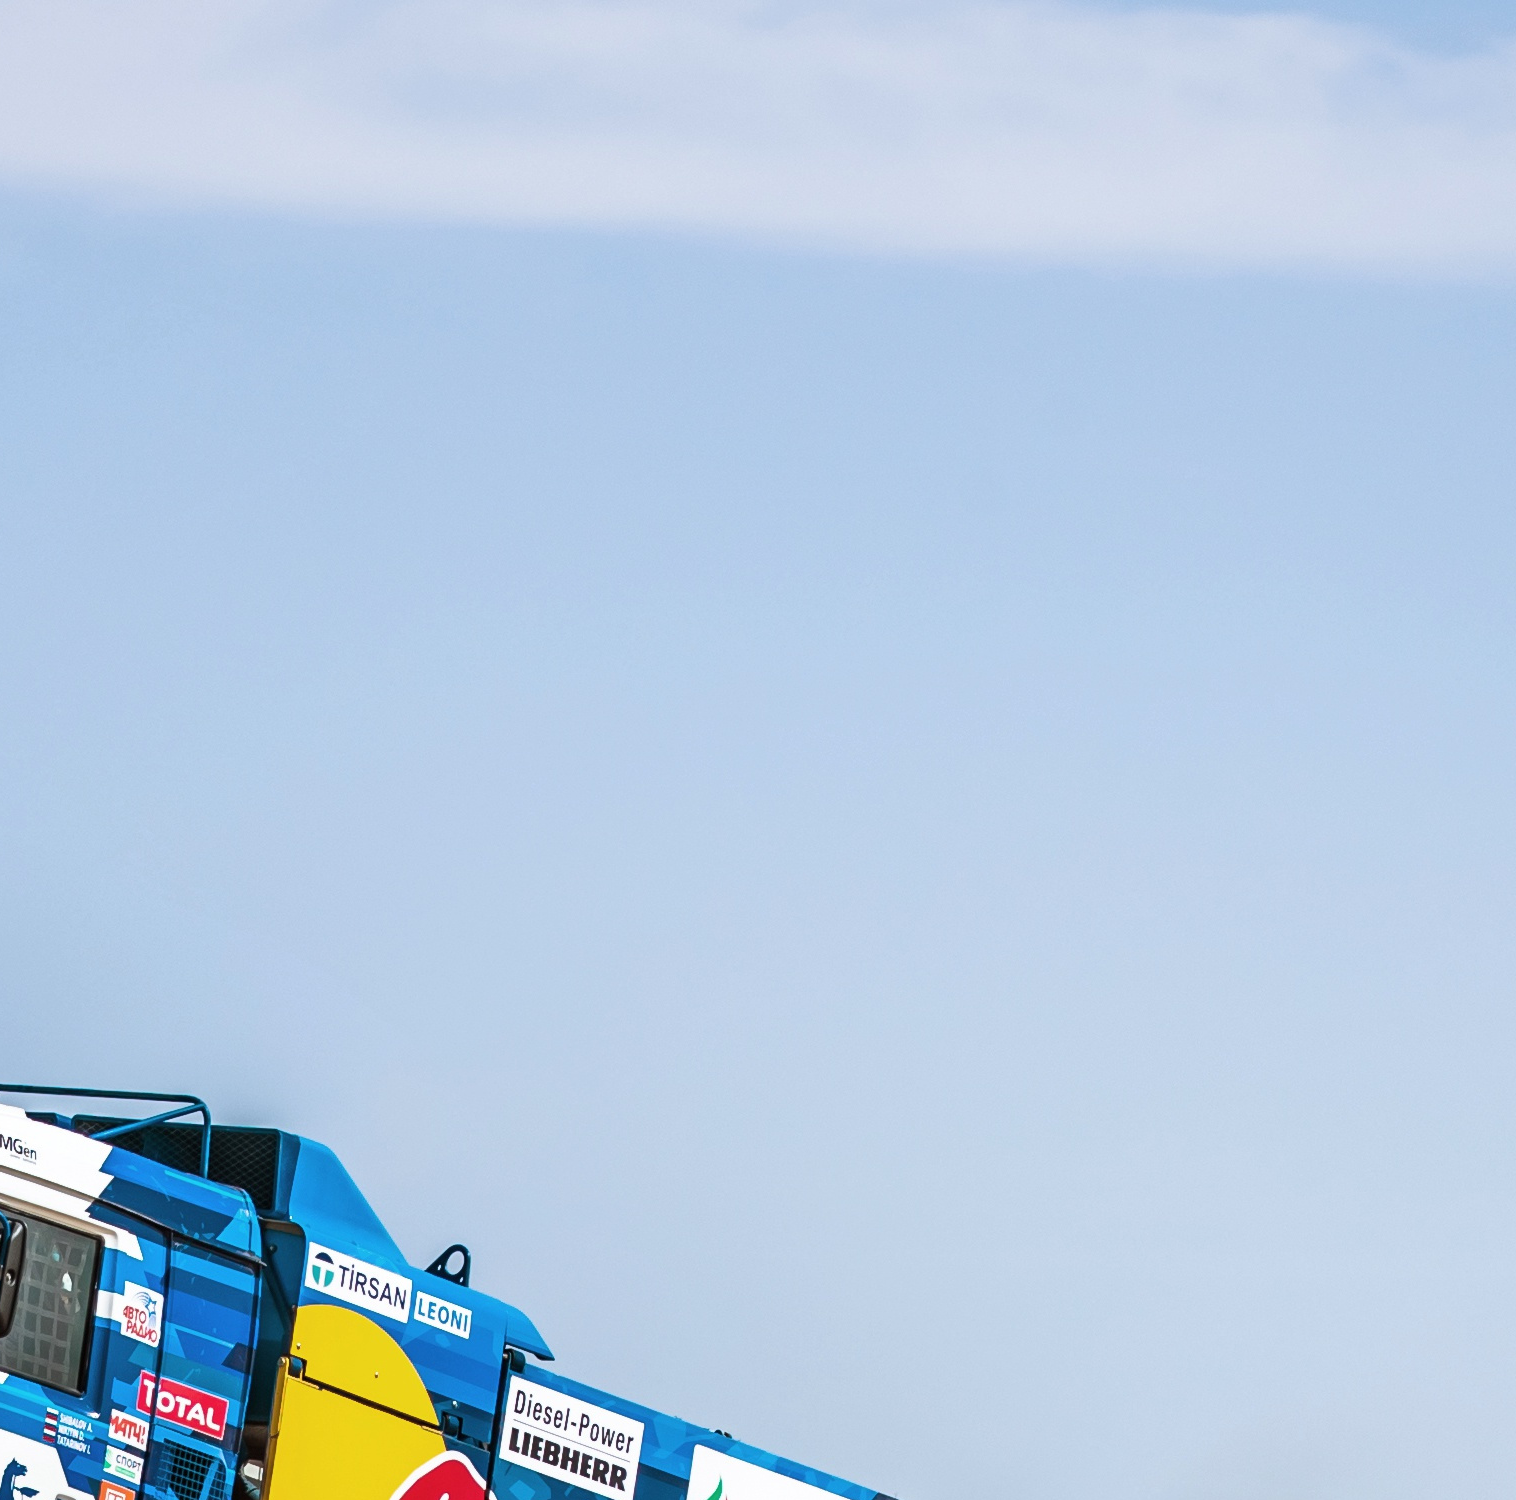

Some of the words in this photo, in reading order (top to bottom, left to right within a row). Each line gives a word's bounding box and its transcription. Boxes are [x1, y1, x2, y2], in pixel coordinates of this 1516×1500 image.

[417, 1297, 469, 1333] LEONI
[142, 1379, 223, 1432] TOTAL
[514, 1389, 635, 1454] Diesel-Power
[508, 1427, 628, 1492] LIEBHERR
